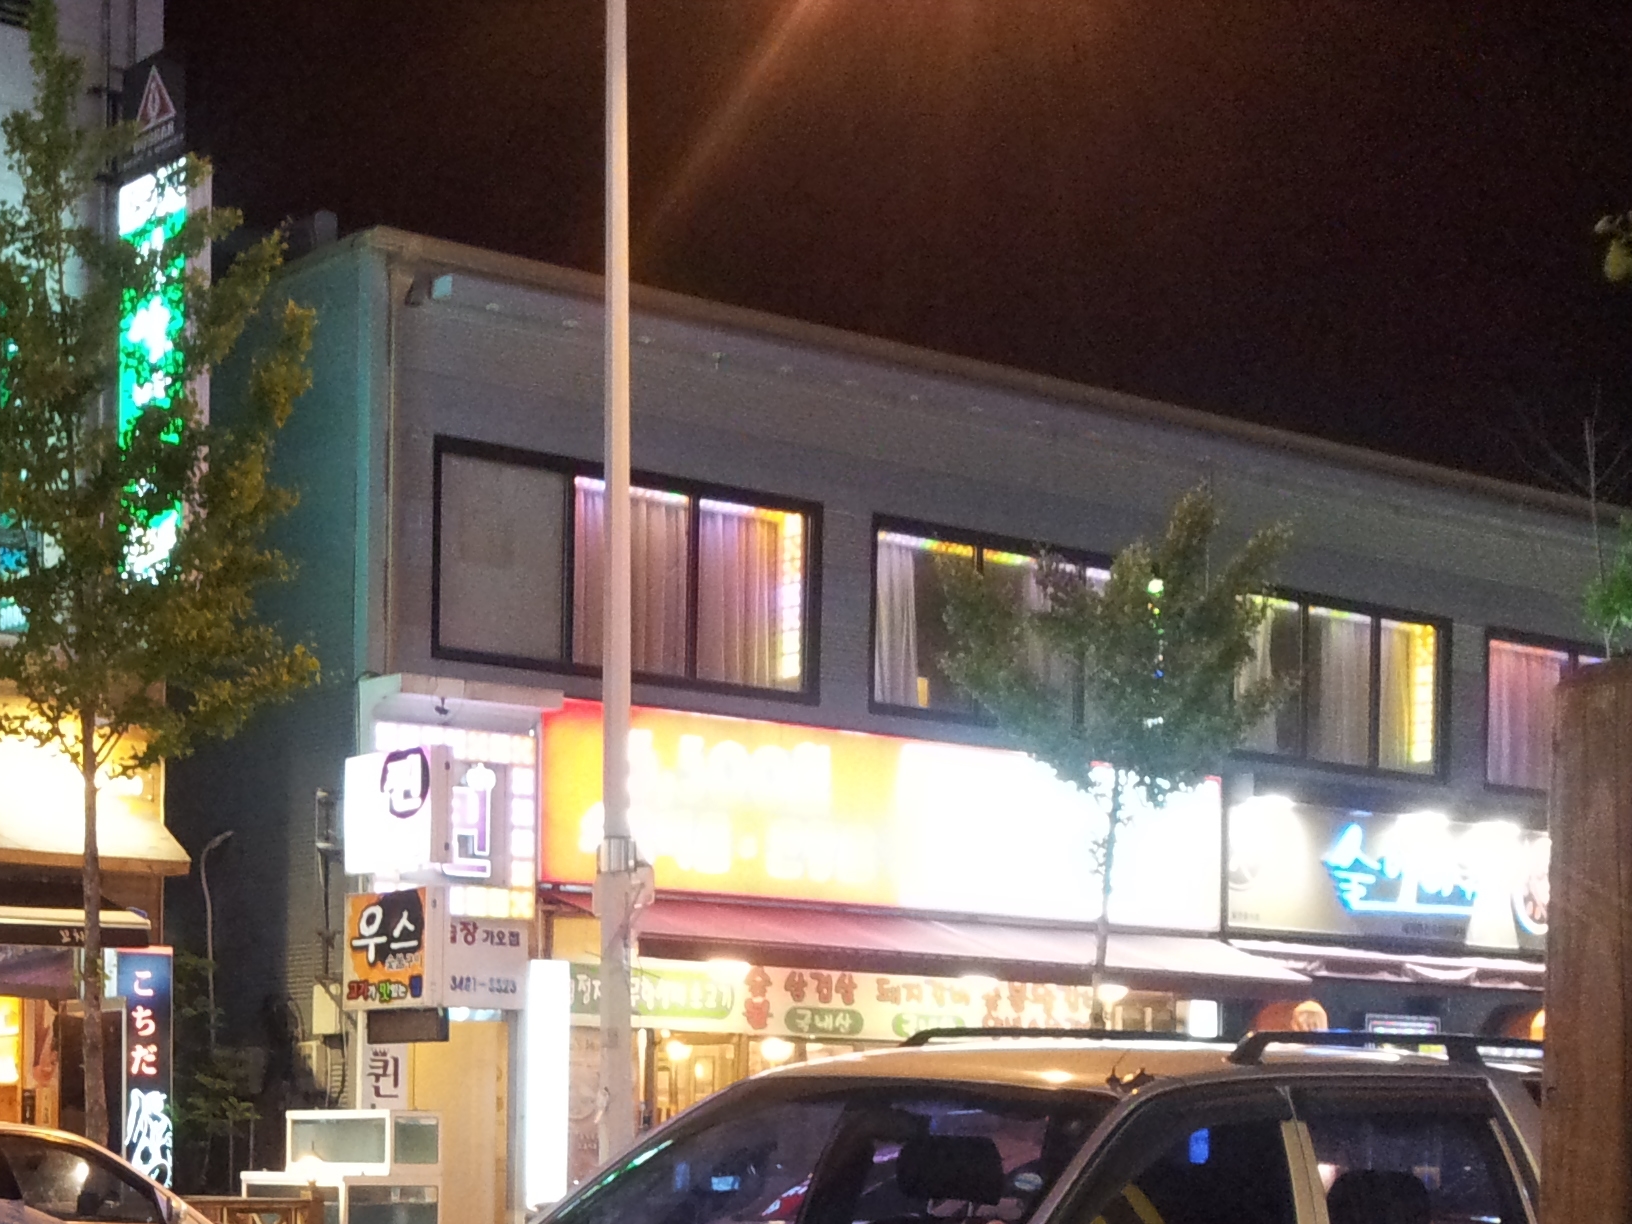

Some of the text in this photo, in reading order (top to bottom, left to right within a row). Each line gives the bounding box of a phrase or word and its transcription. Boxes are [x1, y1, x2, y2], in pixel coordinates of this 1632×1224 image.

[351, 904, 419, 964] 우스
[130, 970, 158, 1076] こちだ
[795, 1008, 852, 1032] 국내산
[367, 1056, 399, 1098] 퀸
